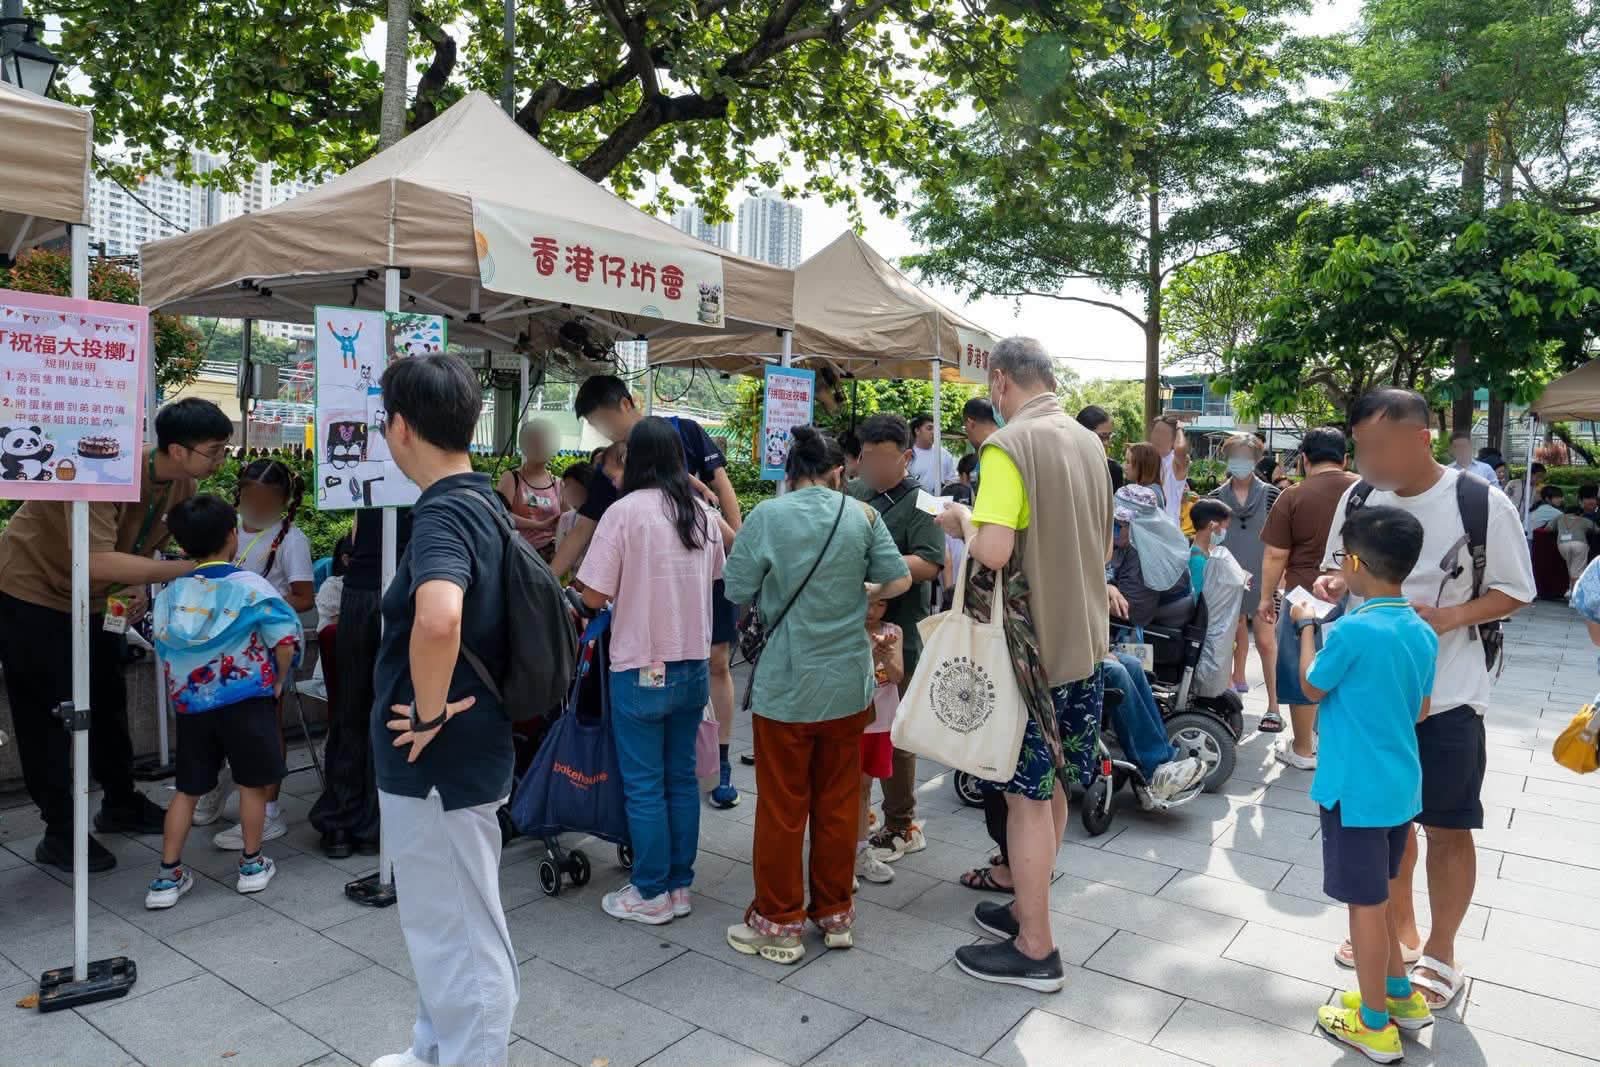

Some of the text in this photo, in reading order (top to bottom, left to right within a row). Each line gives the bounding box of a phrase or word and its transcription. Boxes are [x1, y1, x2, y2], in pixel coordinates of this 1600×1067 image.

[530, 236, 685, 300] 香港仔坊會
[0, 330, 135, 362] 「祝福大投擲」
